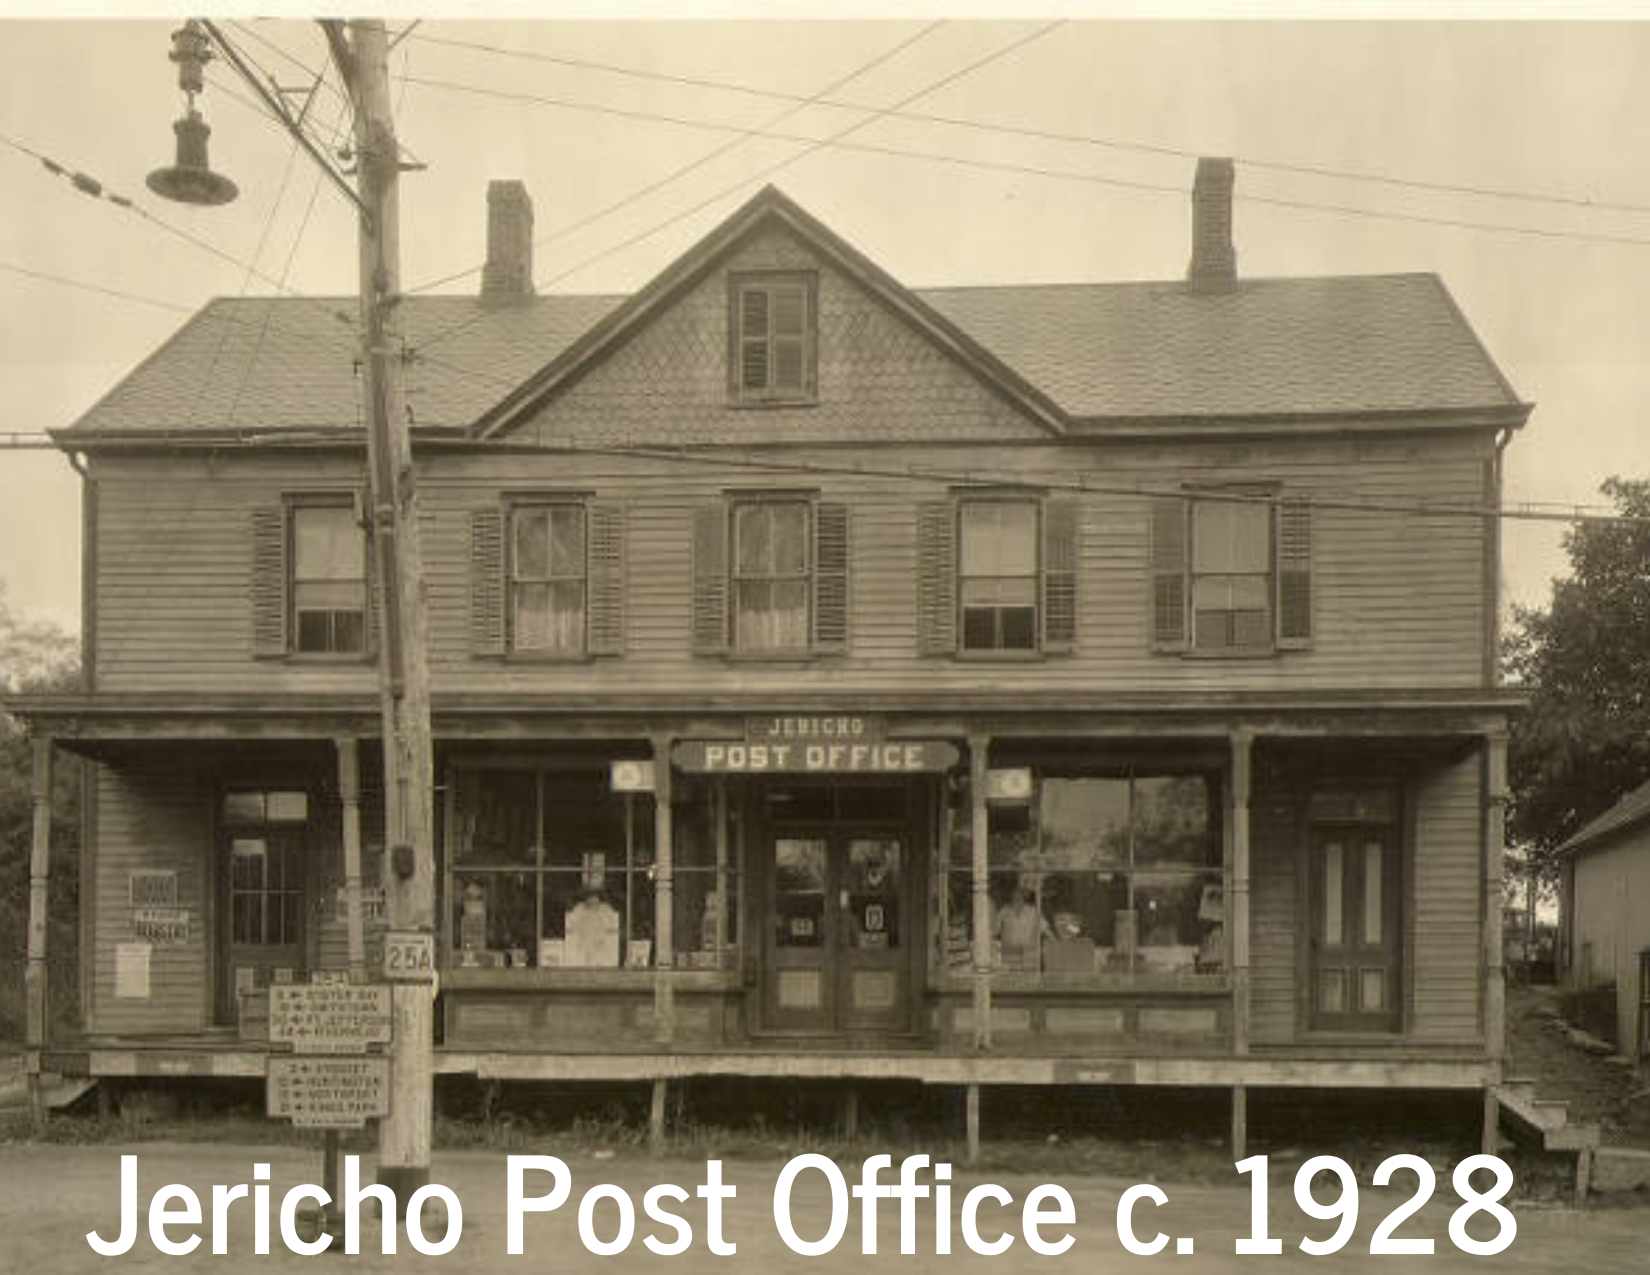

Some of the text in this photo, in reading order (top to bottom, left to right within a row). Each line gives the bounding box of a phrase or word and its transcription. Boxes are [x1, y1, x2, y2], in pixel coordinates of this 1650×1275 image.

[768, 717, 864, 736] JERICHO
[704, 745, 924, 770] POST OFFICE
[390, 945, 431, 970] 25A
